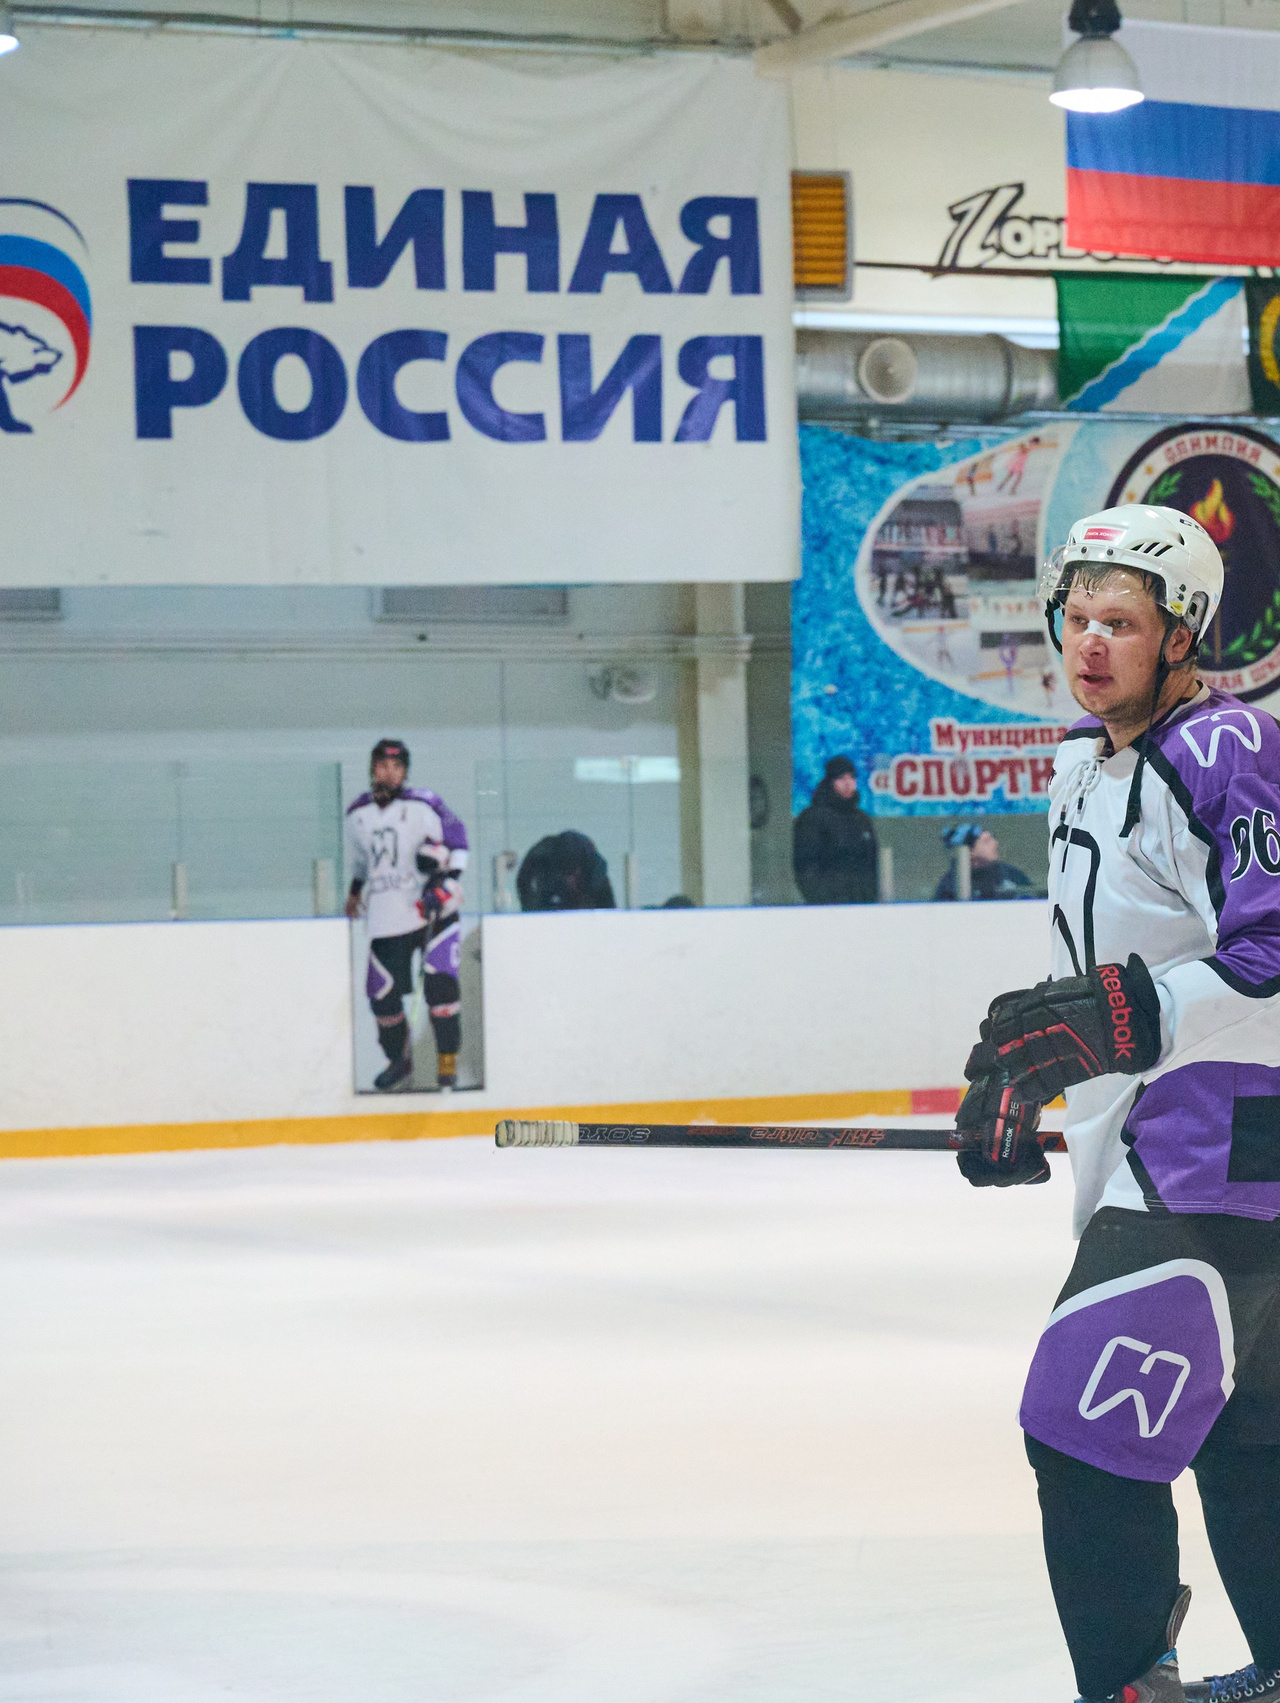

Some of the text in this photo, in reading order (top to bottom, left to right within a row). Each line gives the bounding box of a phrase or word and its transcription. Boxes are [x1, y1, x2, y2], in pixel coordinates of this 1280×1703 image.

[126, 178, 762, 303] ЕДИНАЯ
[132, 325, 767, 443] РОССИЯ
[1164, 435, 1263, 463] ОЛИМПИЯ
[1095, 965, 1136, 1060] Reebok
[750, 1127, 818, 1143] ultra
[1002, 1127, 1013, 1159] Reebok
